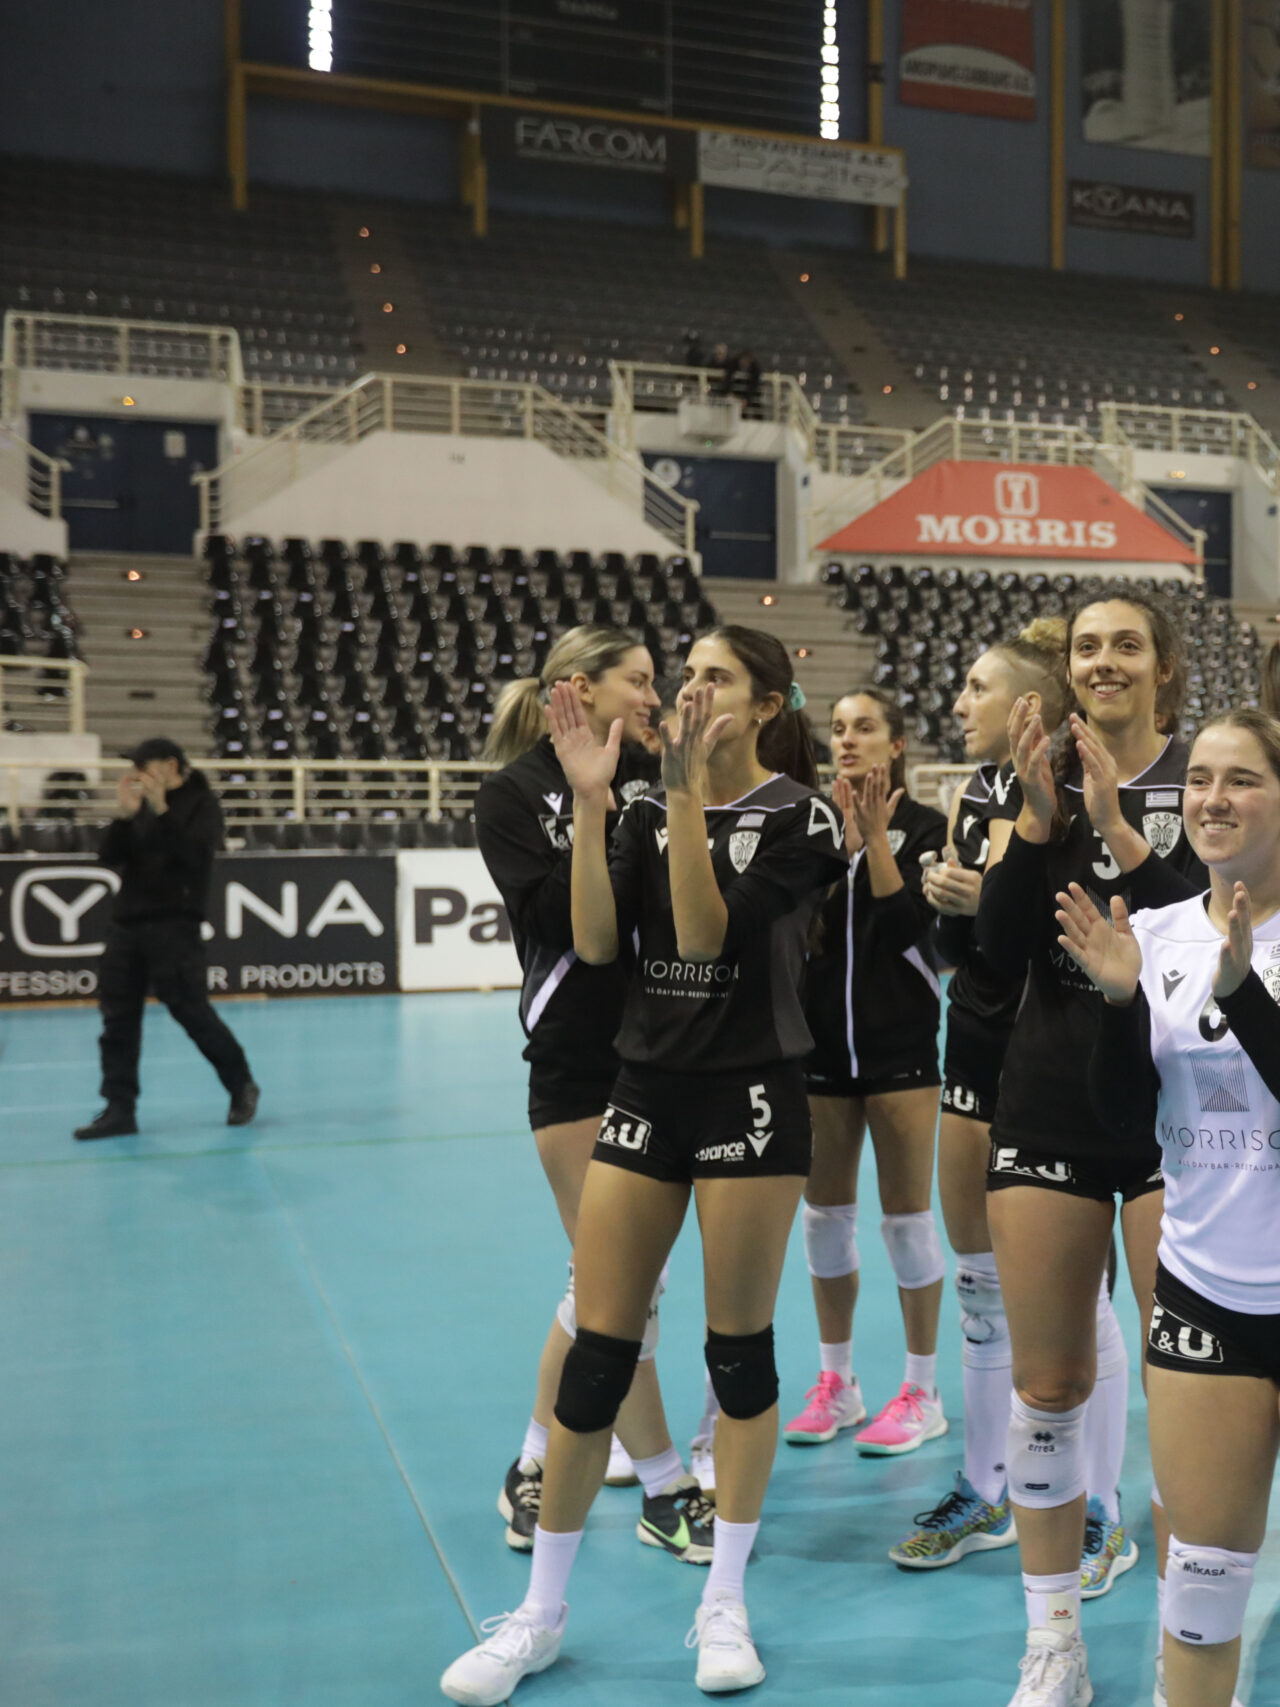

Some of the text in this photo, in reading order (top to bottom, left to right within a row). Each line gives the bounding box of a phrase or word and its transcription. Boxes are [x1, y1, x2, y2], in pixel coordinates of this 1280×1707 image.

[514, 116, 667, 163] FARCOM
[1072, 185, 1191, 220] KYANA
[917, 514, 1117, 548] MORRIS
[241, 962, 386, 989] PRODUCTS
[749, 1084, 772, 1128] 5
